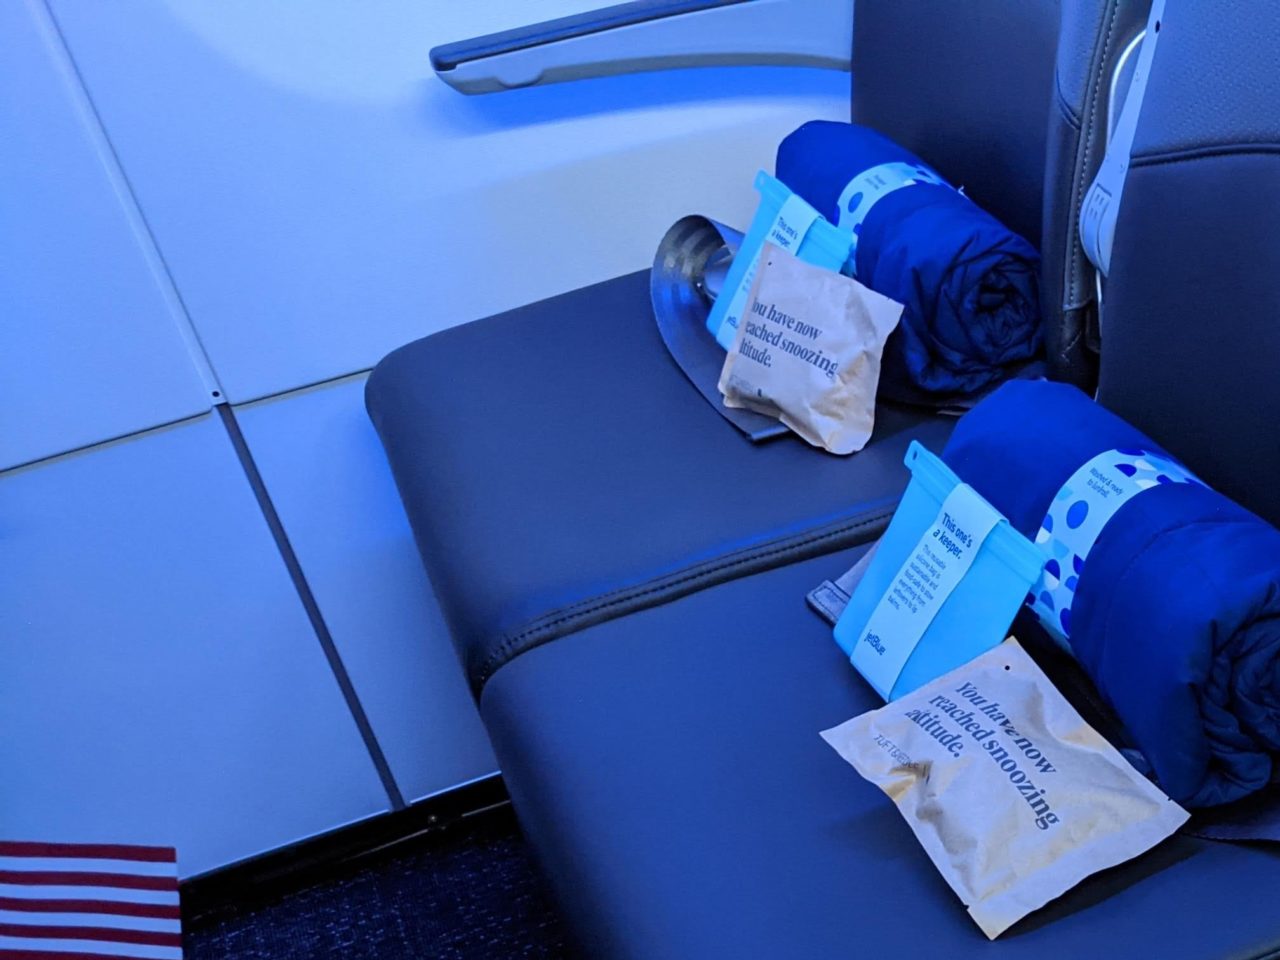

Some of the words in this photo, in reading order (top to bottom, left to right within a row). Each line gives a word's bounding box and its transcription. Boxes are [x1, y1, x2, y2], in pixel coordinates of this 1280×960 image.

[752, 298, 767, 316] ou
[766, 304, 795, 329] have
[795, 320, 823, 340] now
[739, 338, 771, 368] ltitude.
[745, 320, 783, 346] eached
[779, 338, 839, 379] snoozing
[933, 529, 941, 537] a
[938, 532, 963, 559] keeper.
[941, 512, 956, 533] This
[955, 527, 973, 548] one's
[864, 629, 886, 656] jetBlue
[955, 681, 986, 707] You
[981, 702, 1020, 737] have
[1013, 736, 1056, 775] now
[928, 694, 994, 741] reached
[982, 739, 1060, 830] snoozing
